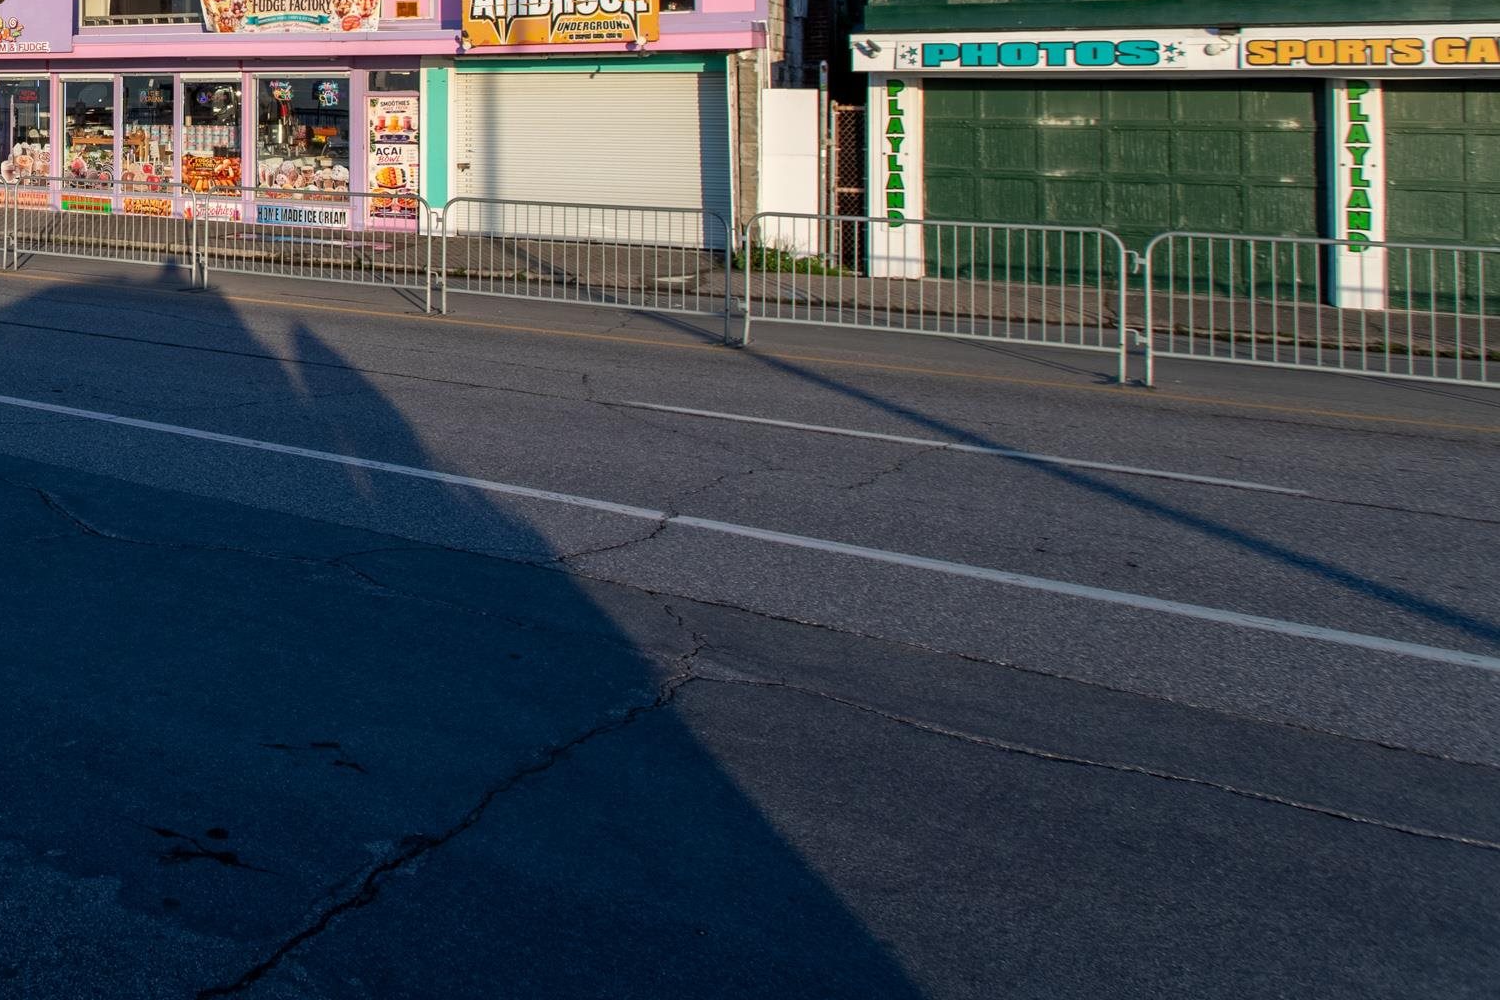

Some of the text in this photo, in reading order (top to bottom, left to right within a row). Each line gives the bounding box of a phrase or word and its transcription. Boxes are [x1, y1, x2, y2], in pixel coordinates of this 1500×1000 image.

[557, 20, 630, 32] UNDERGROUND
[9, 42, 15, 52] &
[921, 39, 1161, 68] PHOTOS
[1245, 37, 1426, 67] SPORTS
[885, 79, 905, 228] PLAYLAND
[1345, 79, 1372, 253] PLAYLAND
[196, 203, 233, 217] Smoothies
[281, 206, 303, 222] MADE
[304, 207, 317, 223] ICE
